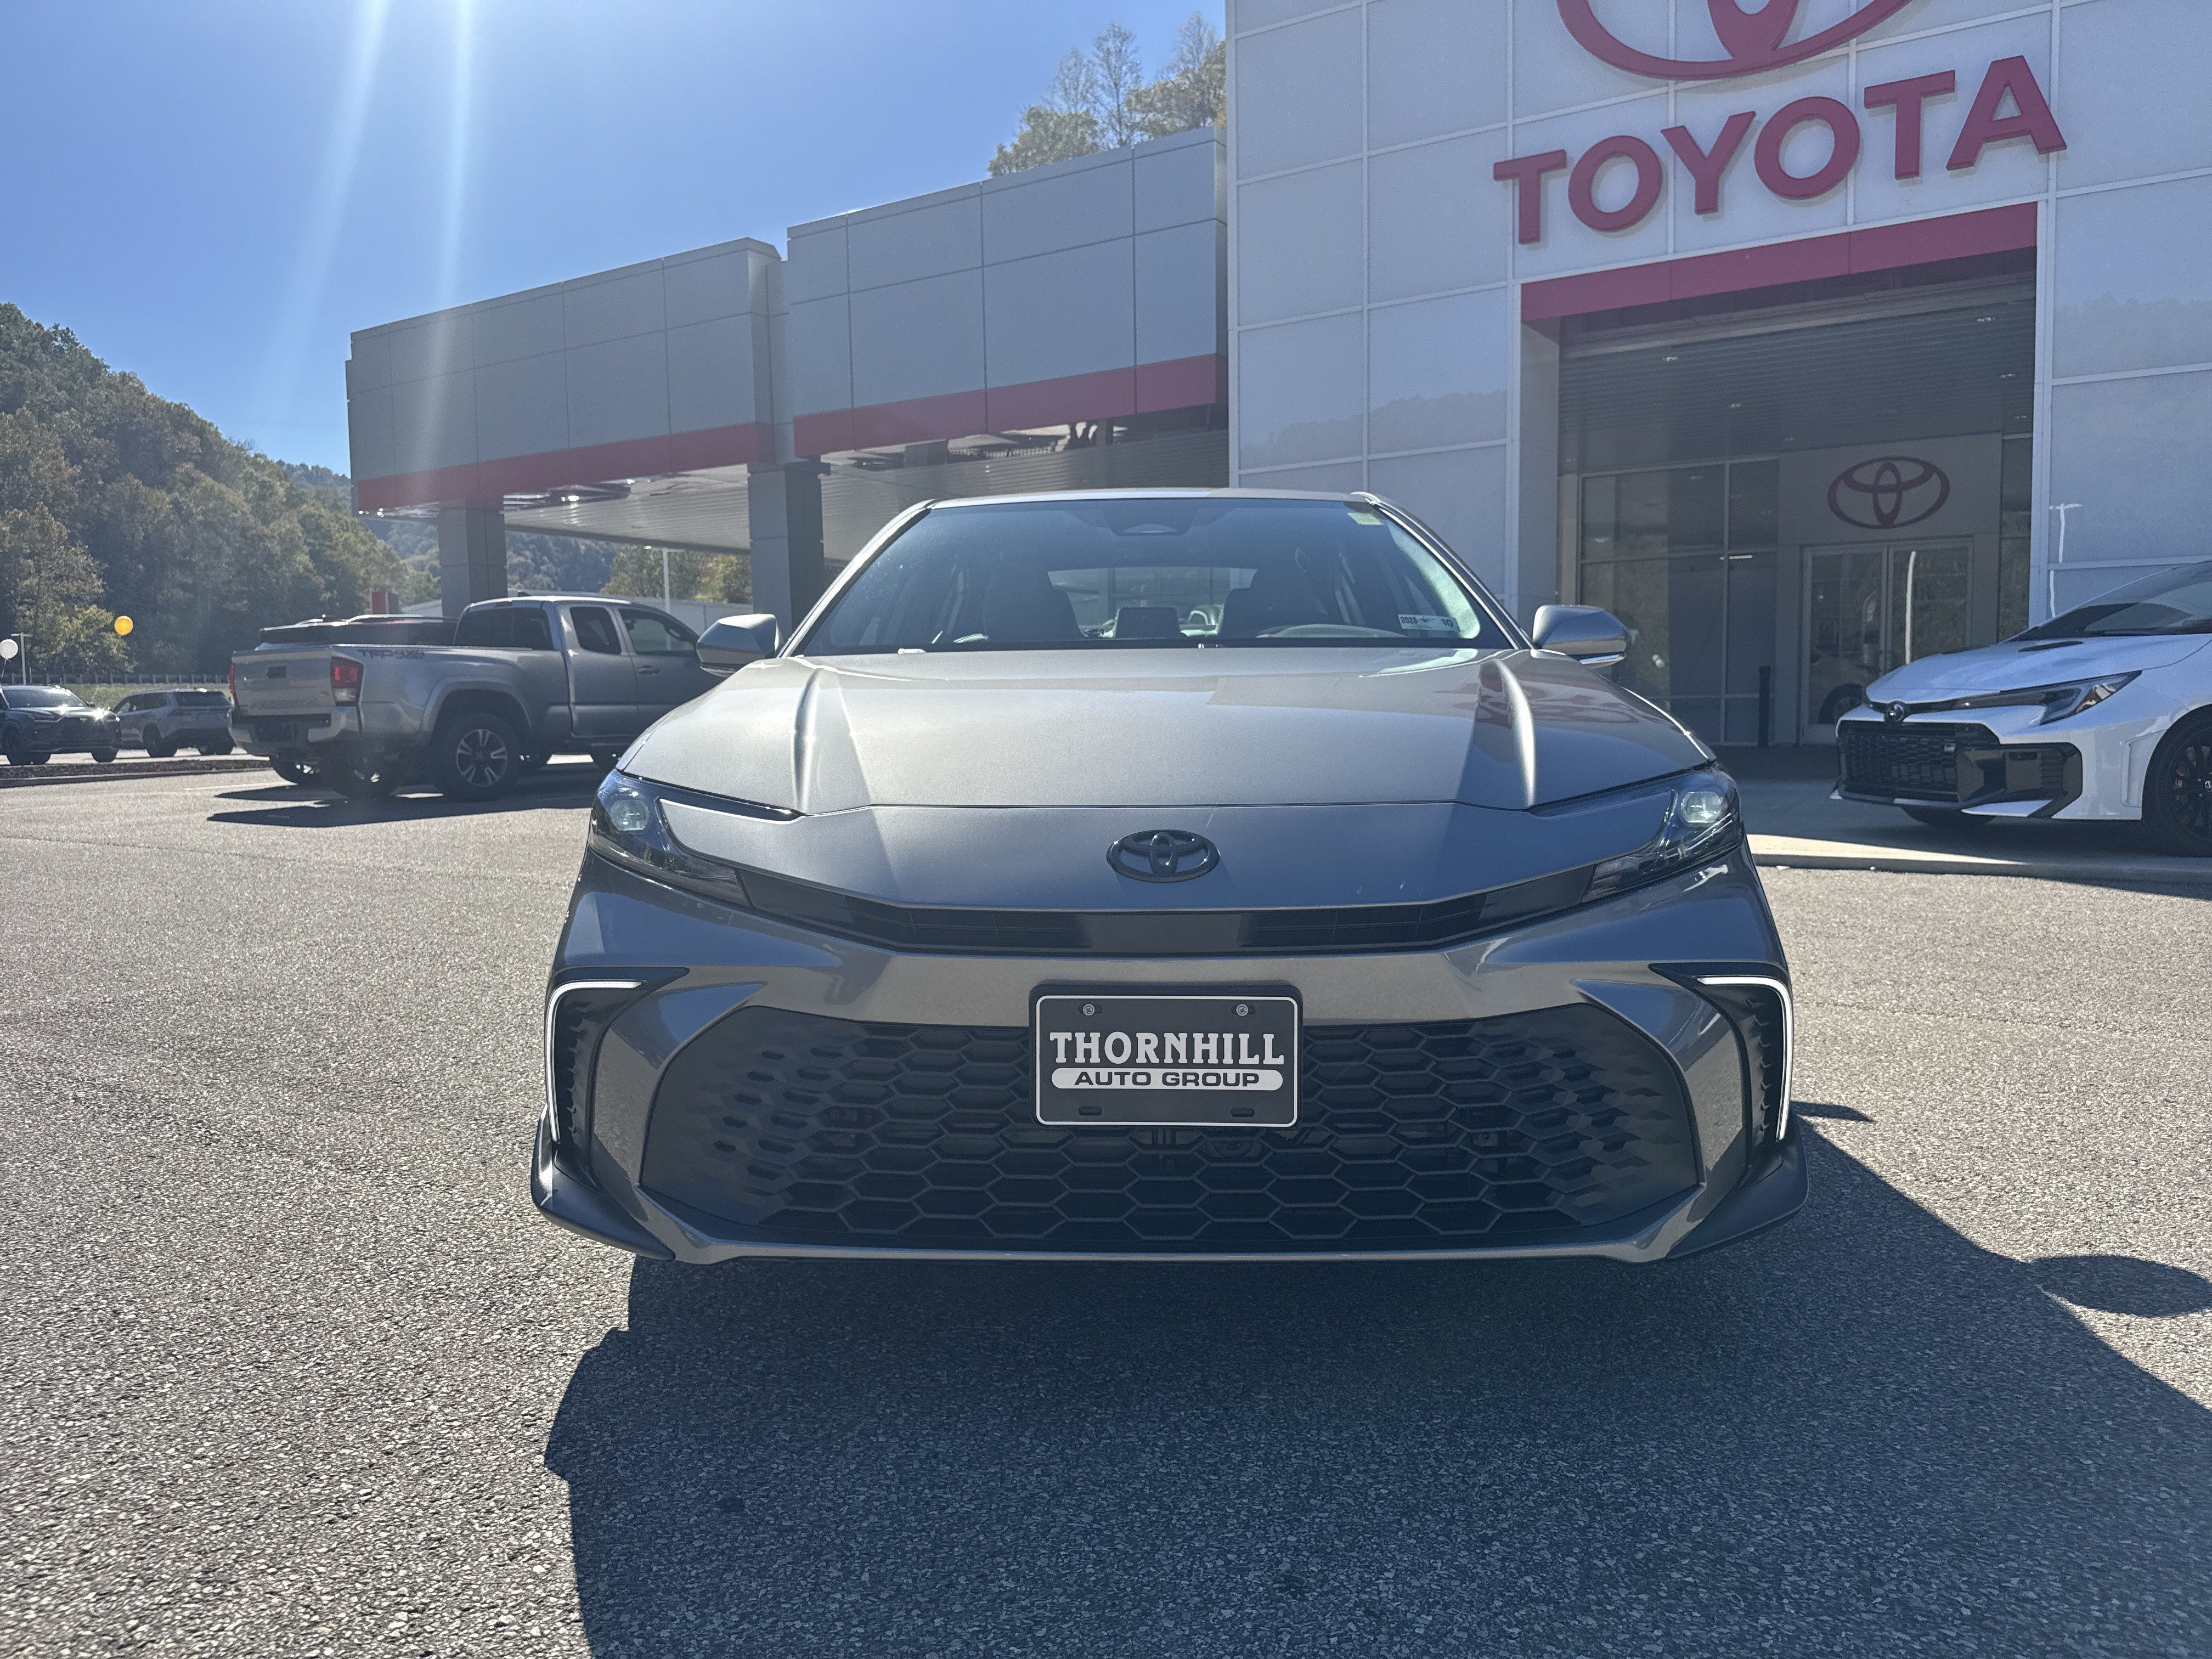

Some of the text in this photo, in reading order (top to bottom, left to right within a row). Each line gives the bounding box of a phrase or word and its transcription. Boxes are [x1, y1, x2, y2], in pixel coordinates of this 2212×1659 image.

[1493, 55, 2067, 245] TOYOTA
[1441, 619, 1454, 627] 10
[1049, 1031, 1284, 1065] THORNHILL
[1074, 1071, 1260, 1087] AUTO GROUP
